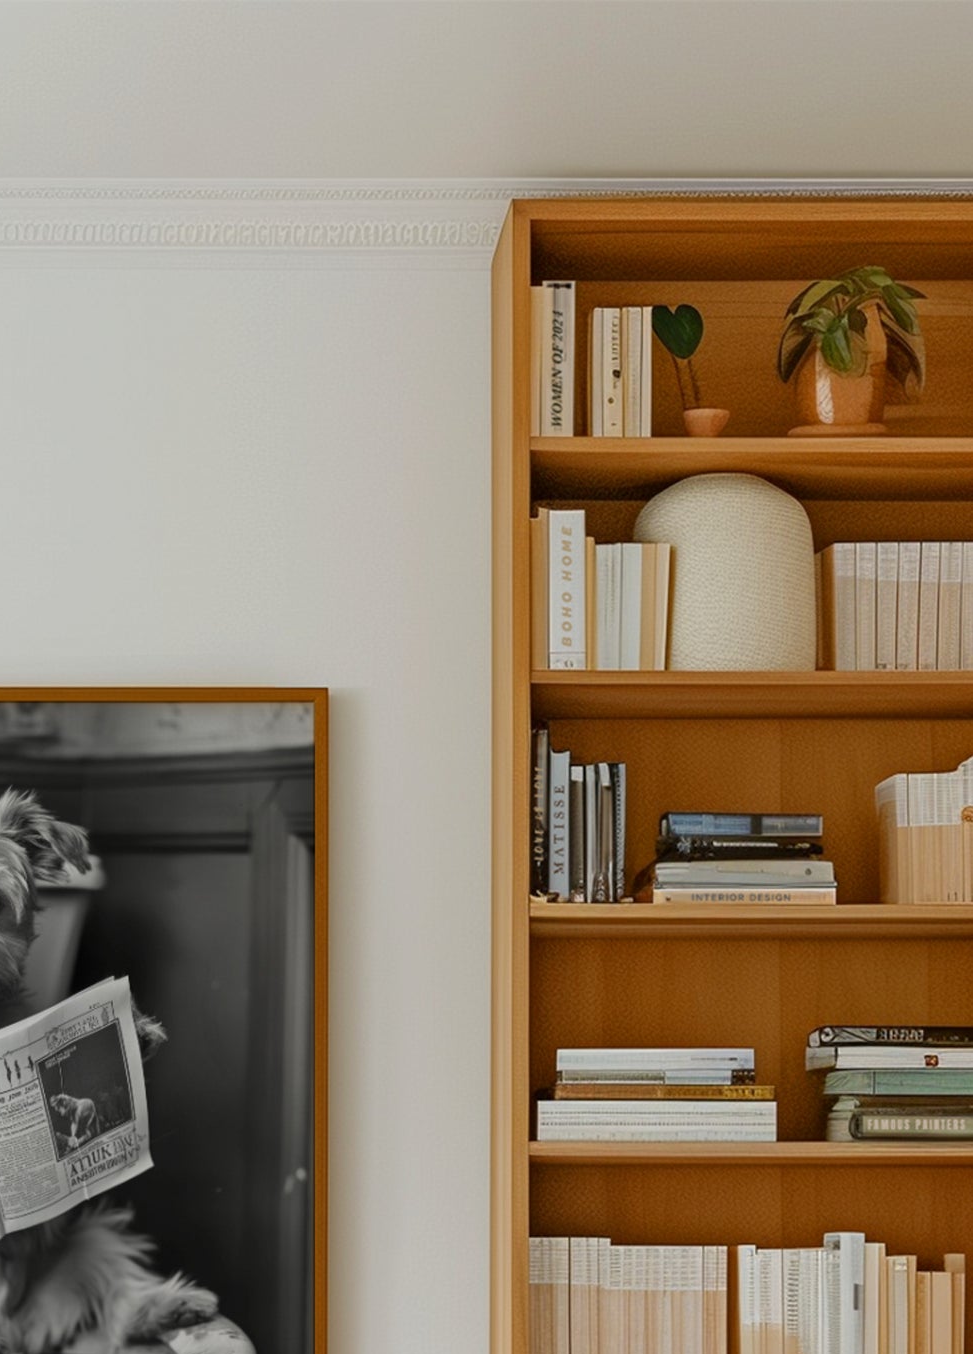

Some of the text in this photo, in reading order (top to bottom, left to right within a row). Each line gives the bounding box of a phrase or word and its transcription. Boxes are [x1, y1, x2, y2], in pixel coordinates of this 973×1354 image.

[551, 310, 564, 428] WOMEN OF 2024
[561, 526, 573, 648] BOHO HOME
[553, 784, 565, 875] MATISSE
[691, 893, 791, 902] INTERIOR DESIGN
[867, 1119, 966, 1131] FAMOUS PAINTERS
